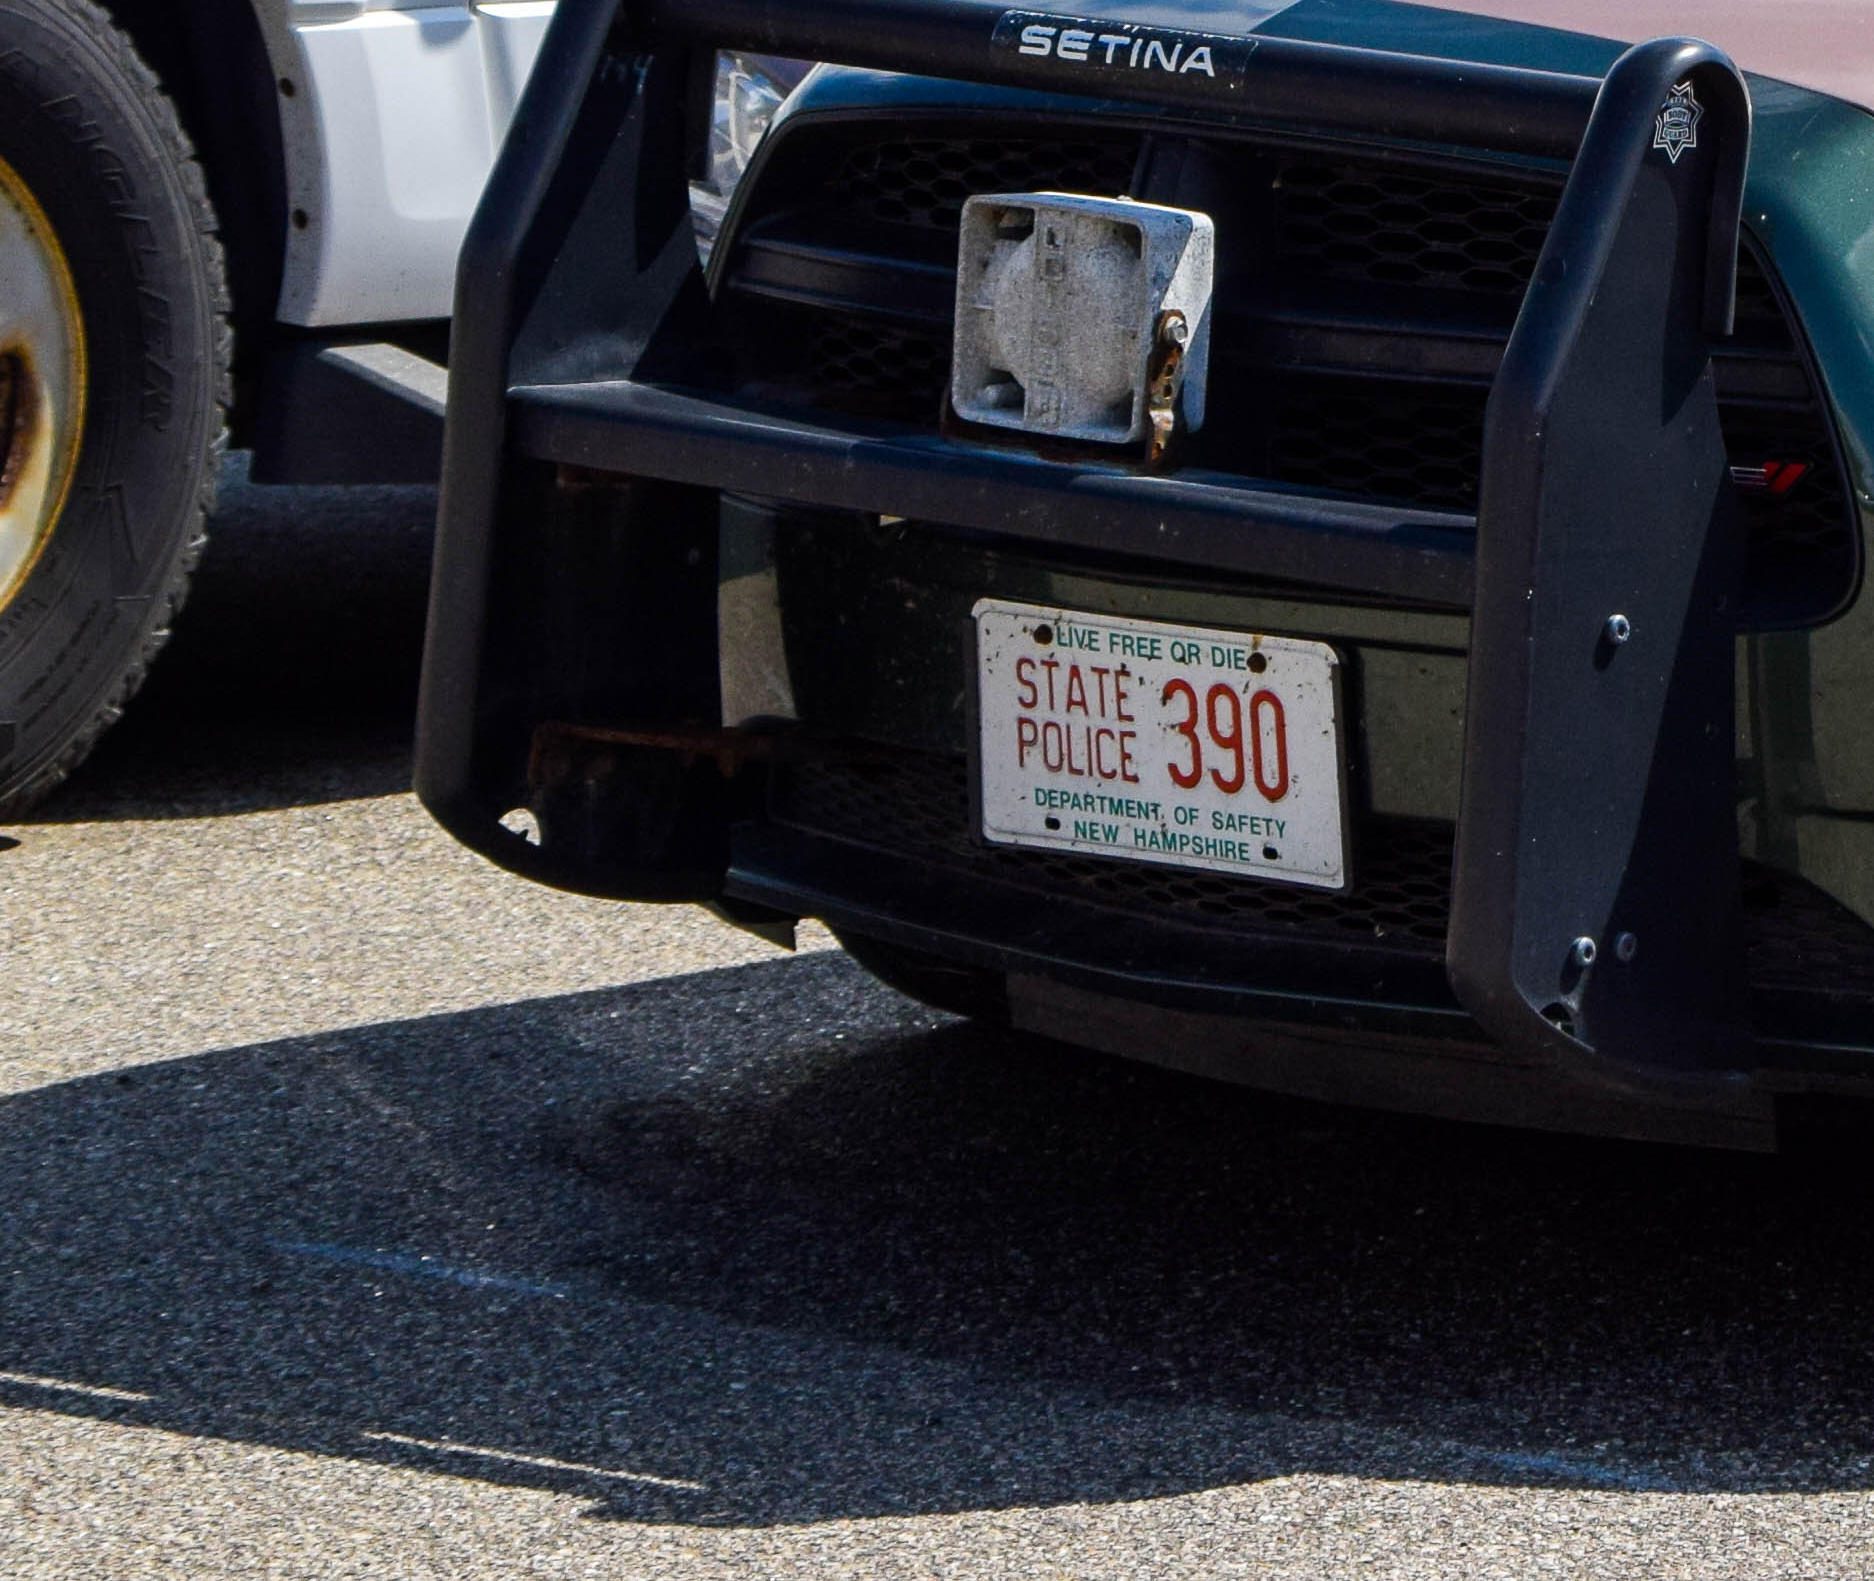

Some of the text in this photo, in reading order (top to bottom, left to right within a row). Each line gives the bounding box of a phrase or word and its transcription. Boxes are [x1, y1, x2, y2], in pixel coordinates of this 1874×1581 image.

[1018, 24, 1216, 78] SETINA
[1055, 626, 1248, 671] LIVE FREE OR DIE
[1016, 656, 1136, 723] STATE
[1016, 716, 1140, 784] POLICE
[1162, 677, 1290, 804] 390
[1034, 787, 1287, 840] DEPARTMENT OF SAFETY
[1073, 820, 1251, 862] NEW HAMPSHIRE
